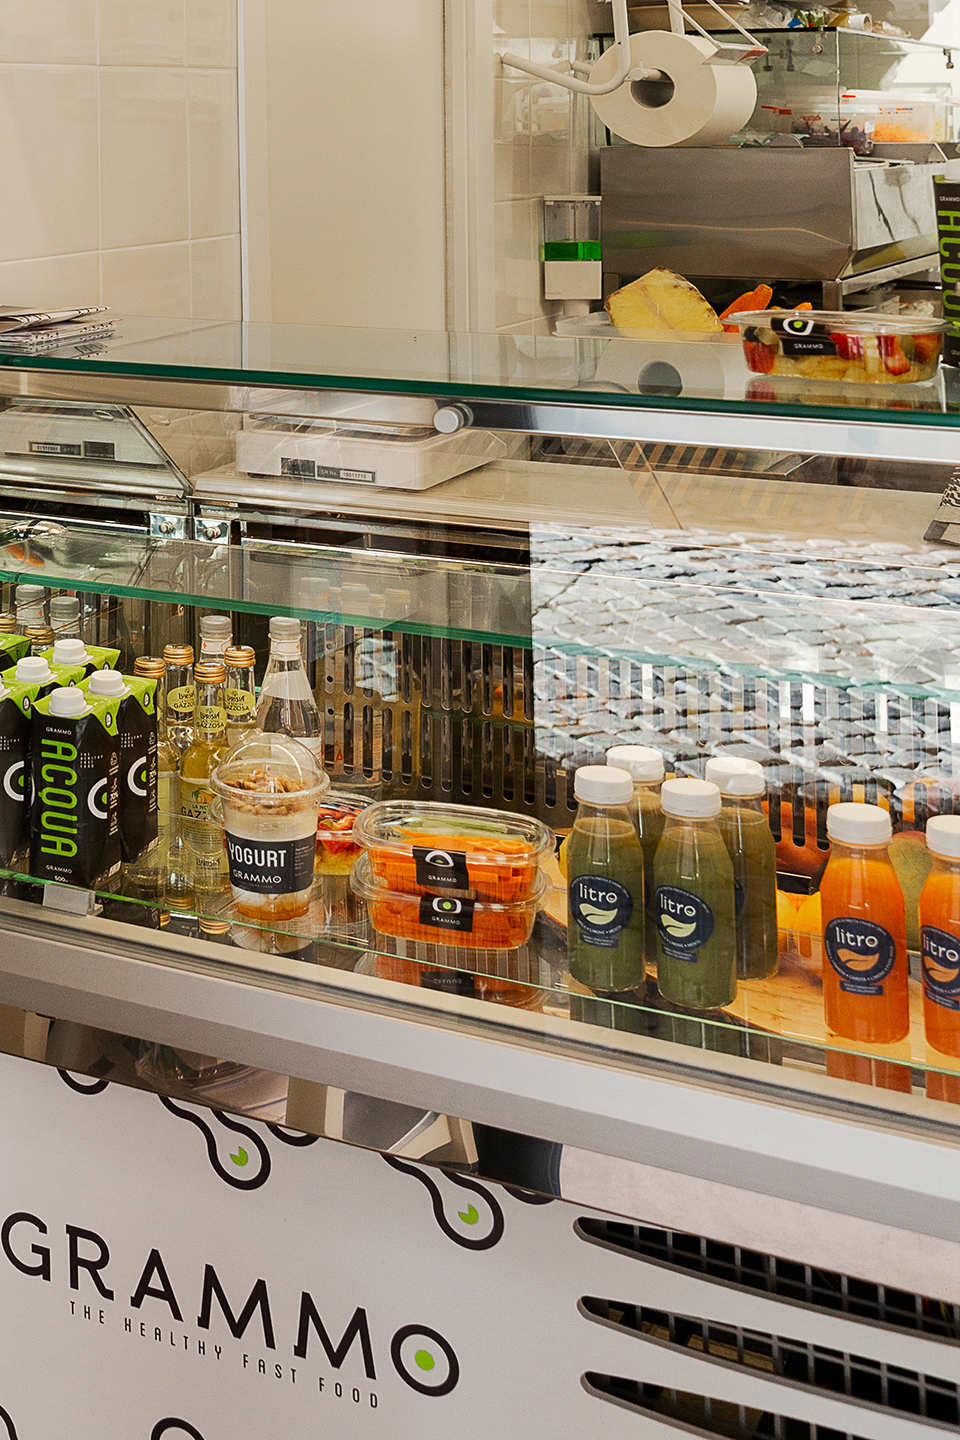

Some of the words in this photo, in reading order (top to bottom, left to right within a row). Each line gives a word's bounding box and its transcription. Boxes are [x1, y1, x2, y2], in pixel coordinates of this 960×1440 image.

[45, 726, 72, 735] GRAMMO
[38, 738, 78, 858] ACQUA
[228, 841, 287, 868] YOGURT
[45, 864, 73, 874] GRAMMO
[233, 869, 282, 884] GRAMMO
[427, 874, 457, 883] GRAMMO
[579, 883, 617, 904] litro
[660, 893, 696, 917] litro
[431, 915, 461, 925] GRAMMO
[835, 926, 878, 948] litro
[922, 933, 959, 962] litro
[0, 1211, 460, 1397] GRAMMO
[69, 1300, 106, 1325] THE
[124, 1316, 222, 1360] HEALTHY
[242, 1353, 297, 1384] FAST
[318, 1376, 379, 1409] FOOD
